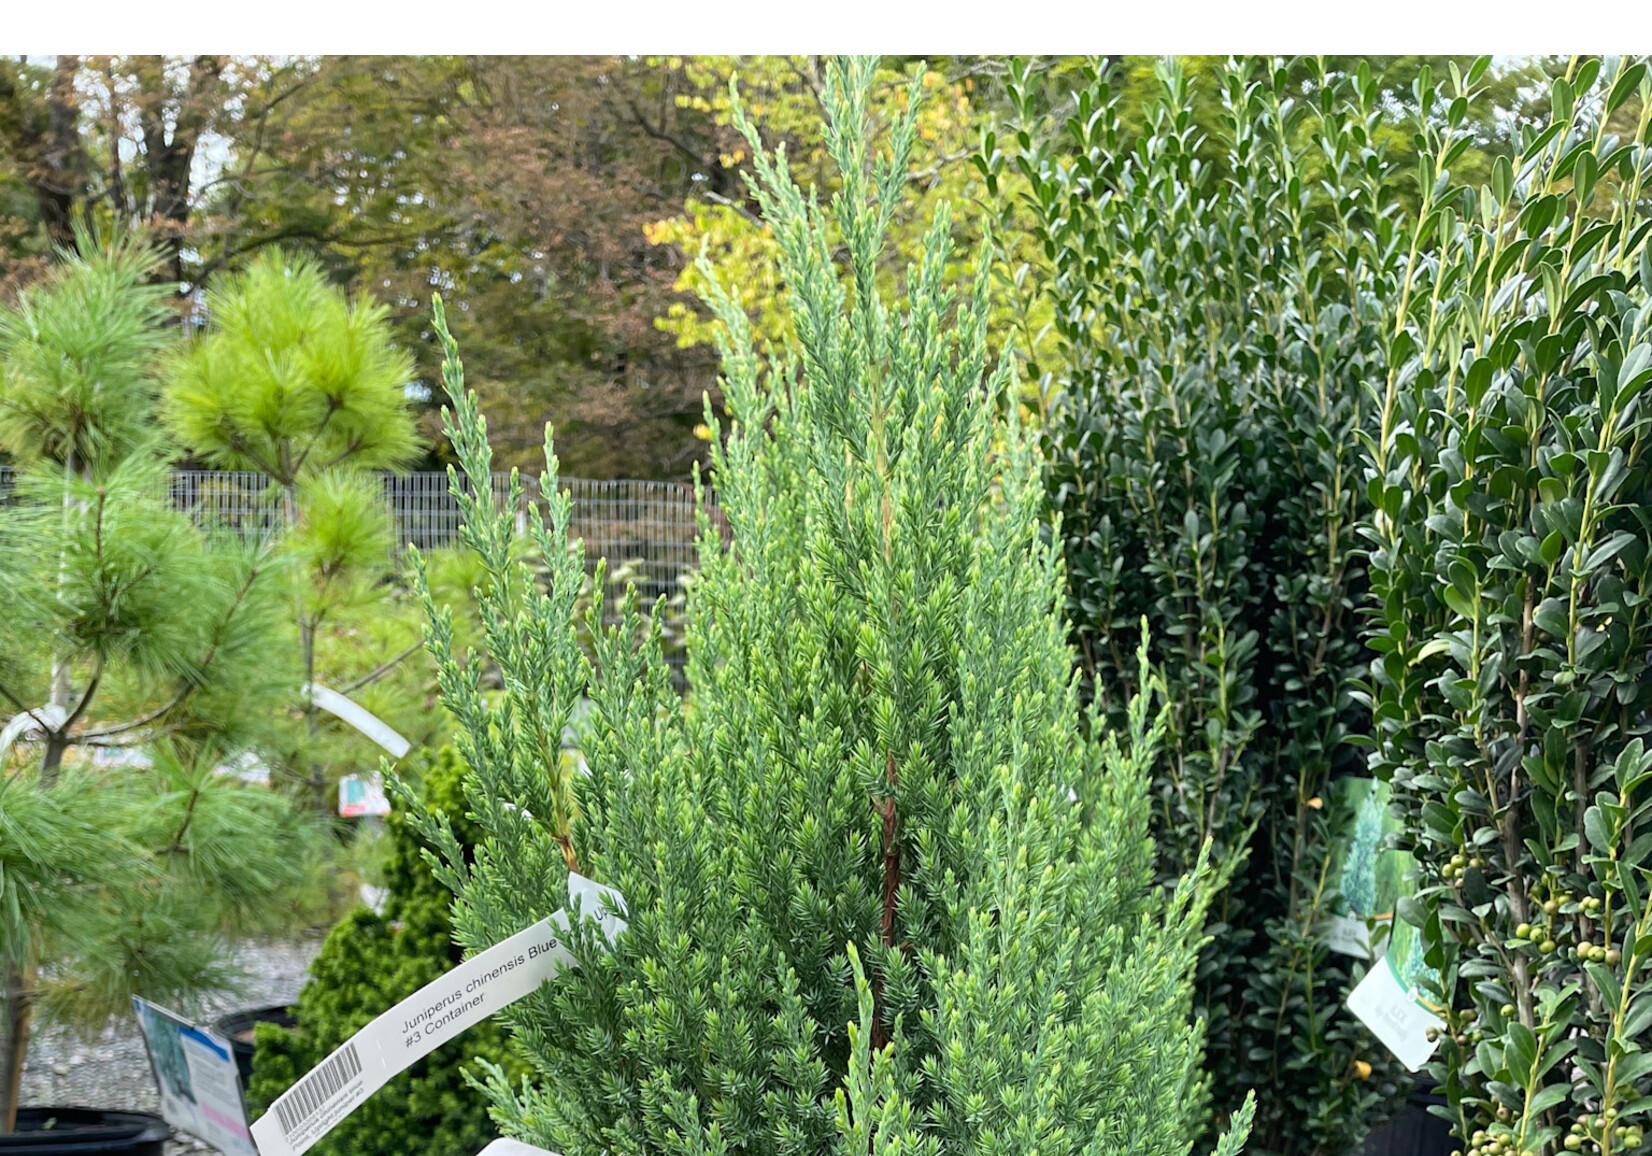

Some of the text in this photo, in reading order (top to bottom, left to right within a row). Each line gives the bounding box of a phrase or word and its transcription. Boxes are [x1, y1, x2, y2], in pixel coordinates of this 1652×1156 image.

[402, 989, 462, 1034] Juniperus
[466, 955, 525, 992] chinensis
[528, 938, 557, 960] Blue
[405, 992, 486, 1048] #3 Container
